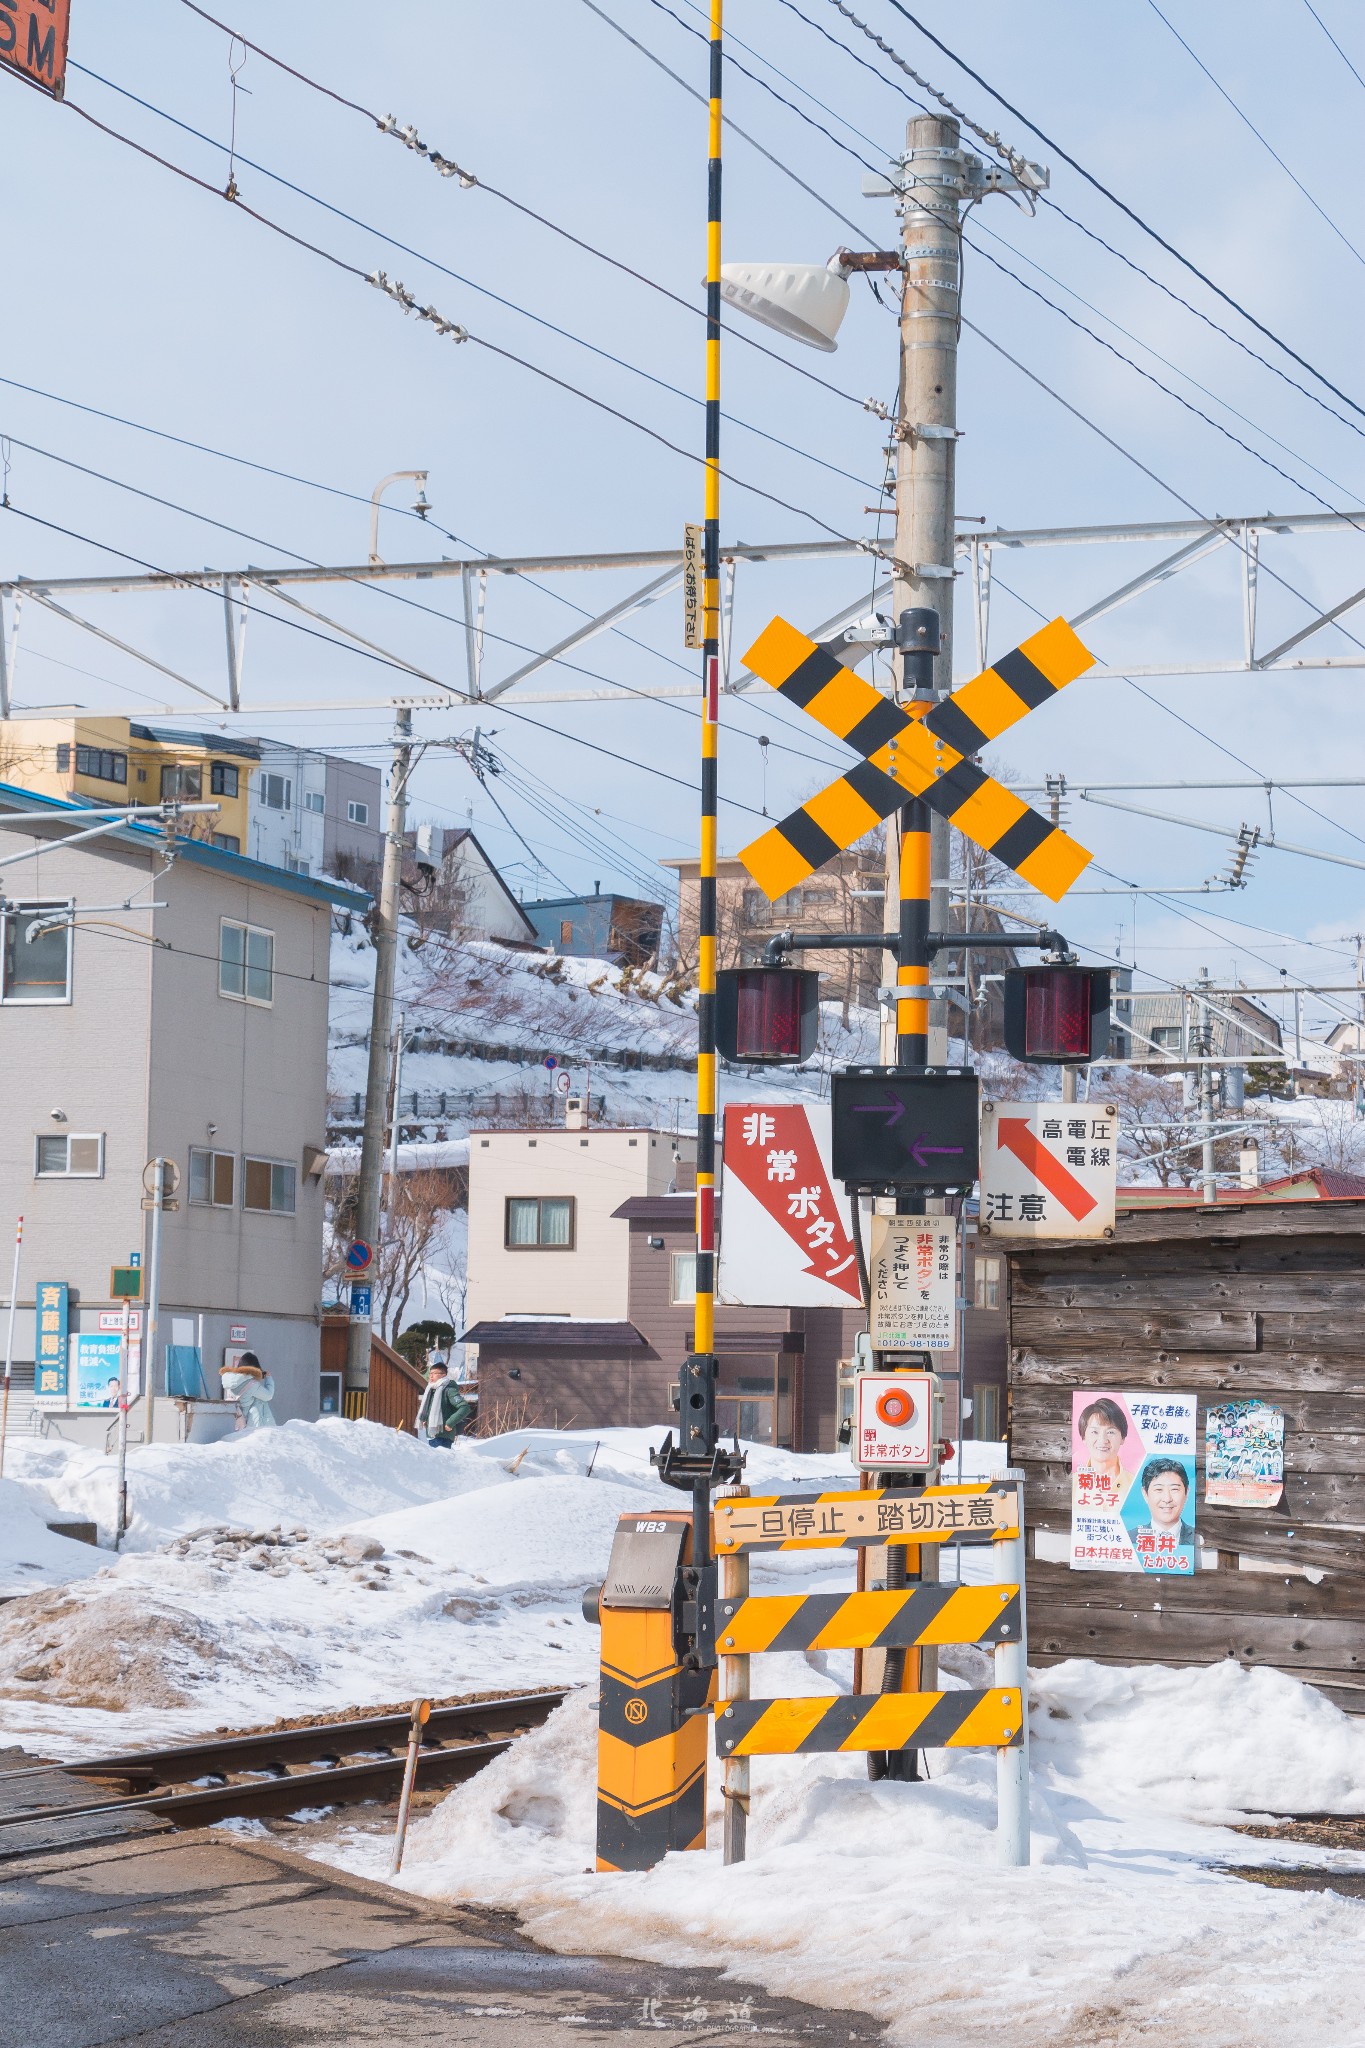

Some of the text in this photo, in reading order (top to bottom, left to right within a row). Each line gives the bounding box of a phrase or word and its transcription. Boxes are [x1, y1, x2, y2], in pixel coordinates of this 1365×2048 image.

[685, 526, 697, 646] しばらくお待ち下さい
[1042, 1119, 1111, 1139] 高電圧
[1066, 1146, 1110, 1166] 電線
[743, 1112, 855, 1277] 非常ボタン
[986, 1193, 1047, 1221] 注意
[893, 1236, 909, 1290] つよく押して
[916, 1233, 934, 1300] 非常ボタンを
[938, 1235, 949, 1280] 非常の際は
[877, 1258, 888, 1300] ください
[1131, 1404, 1191, 1418] 子育ても老後も
[1141, 1418, 1168, 1430] 安心の
[1153, 1433, 1190, 1445] 北海道を
[864, 1443, 925, 1458] 非常ボタン
[1078, 1473, 1111, 1491] 菊地
[1077, 1493, 1120, 1507] よう子
[635, 1521, 667, 1533] WB3
[1074, 1546, 1133, 1560] 日本共産党
[1136, 1535, 1176, 1553] 酒井
[1143, 1554, 1189, 1569] たかひろ
